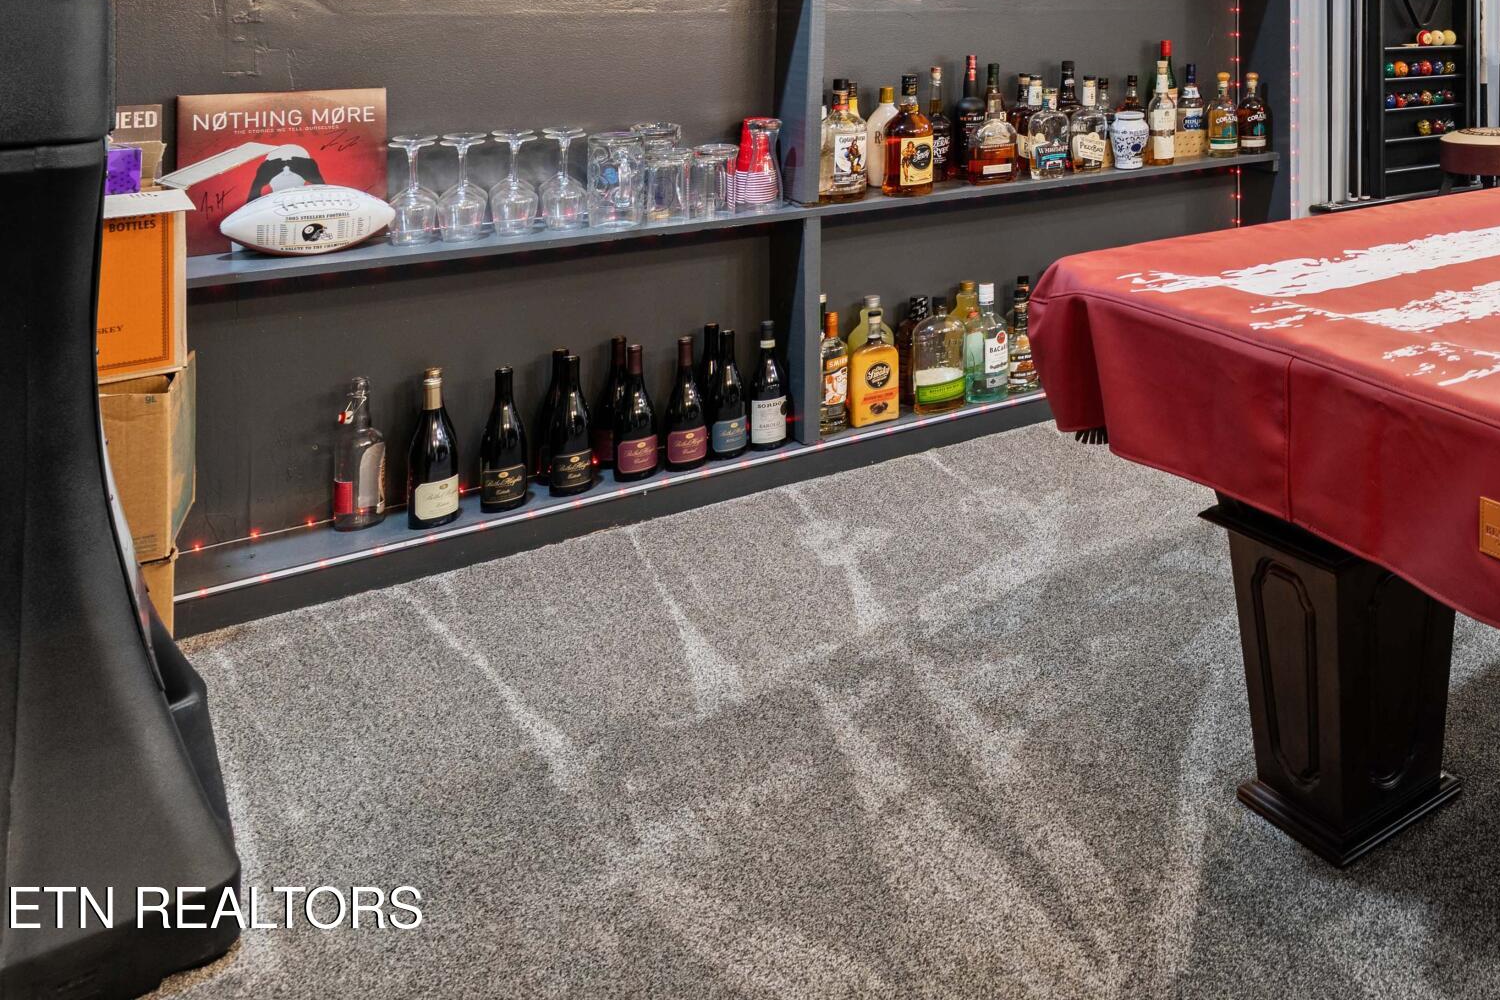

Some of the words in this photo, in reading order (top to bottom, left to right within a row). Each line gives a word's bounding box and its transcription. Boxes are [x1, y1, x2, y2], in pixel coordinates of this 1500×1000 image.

[193, 109, 303, 132] NØTHING
[312, 106, 376, 125] MØRE
[109, 219, 157, 232] BOTTLES
[757, 400, 782, 409] SORDO
